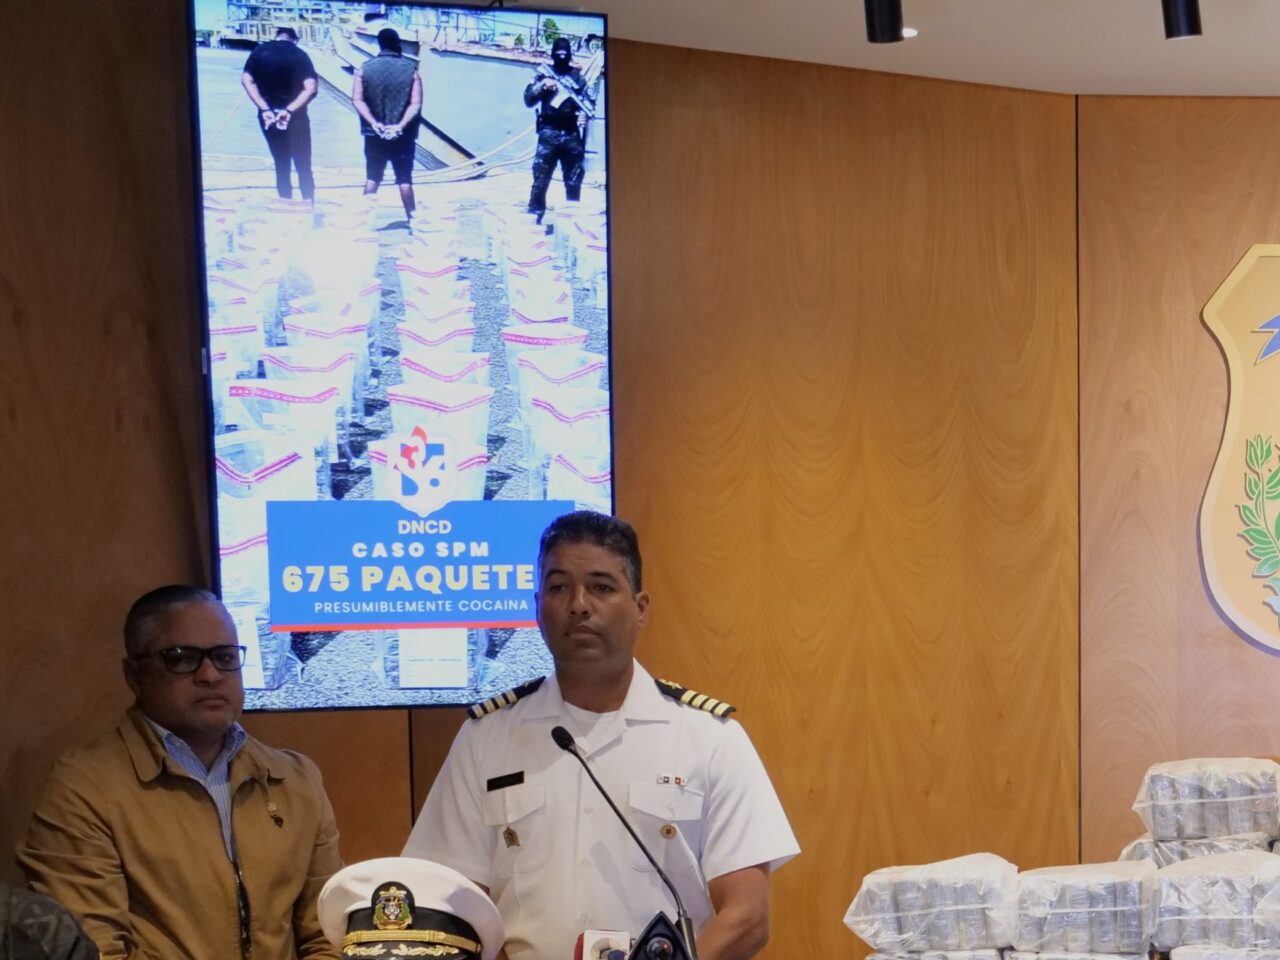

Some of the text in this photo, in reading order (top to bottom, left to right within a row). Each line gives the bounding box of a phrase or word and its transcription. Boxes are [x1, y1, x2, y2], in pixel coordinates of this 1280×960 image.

[398, 520, 452, 534] DNCD
[352, 542, 489, 558] CASO SPM
[282, 564, 534, 594] 675 PAQUETE
[314, 599, 529, 613] PRESUMIBLEMENTE COCAINA
